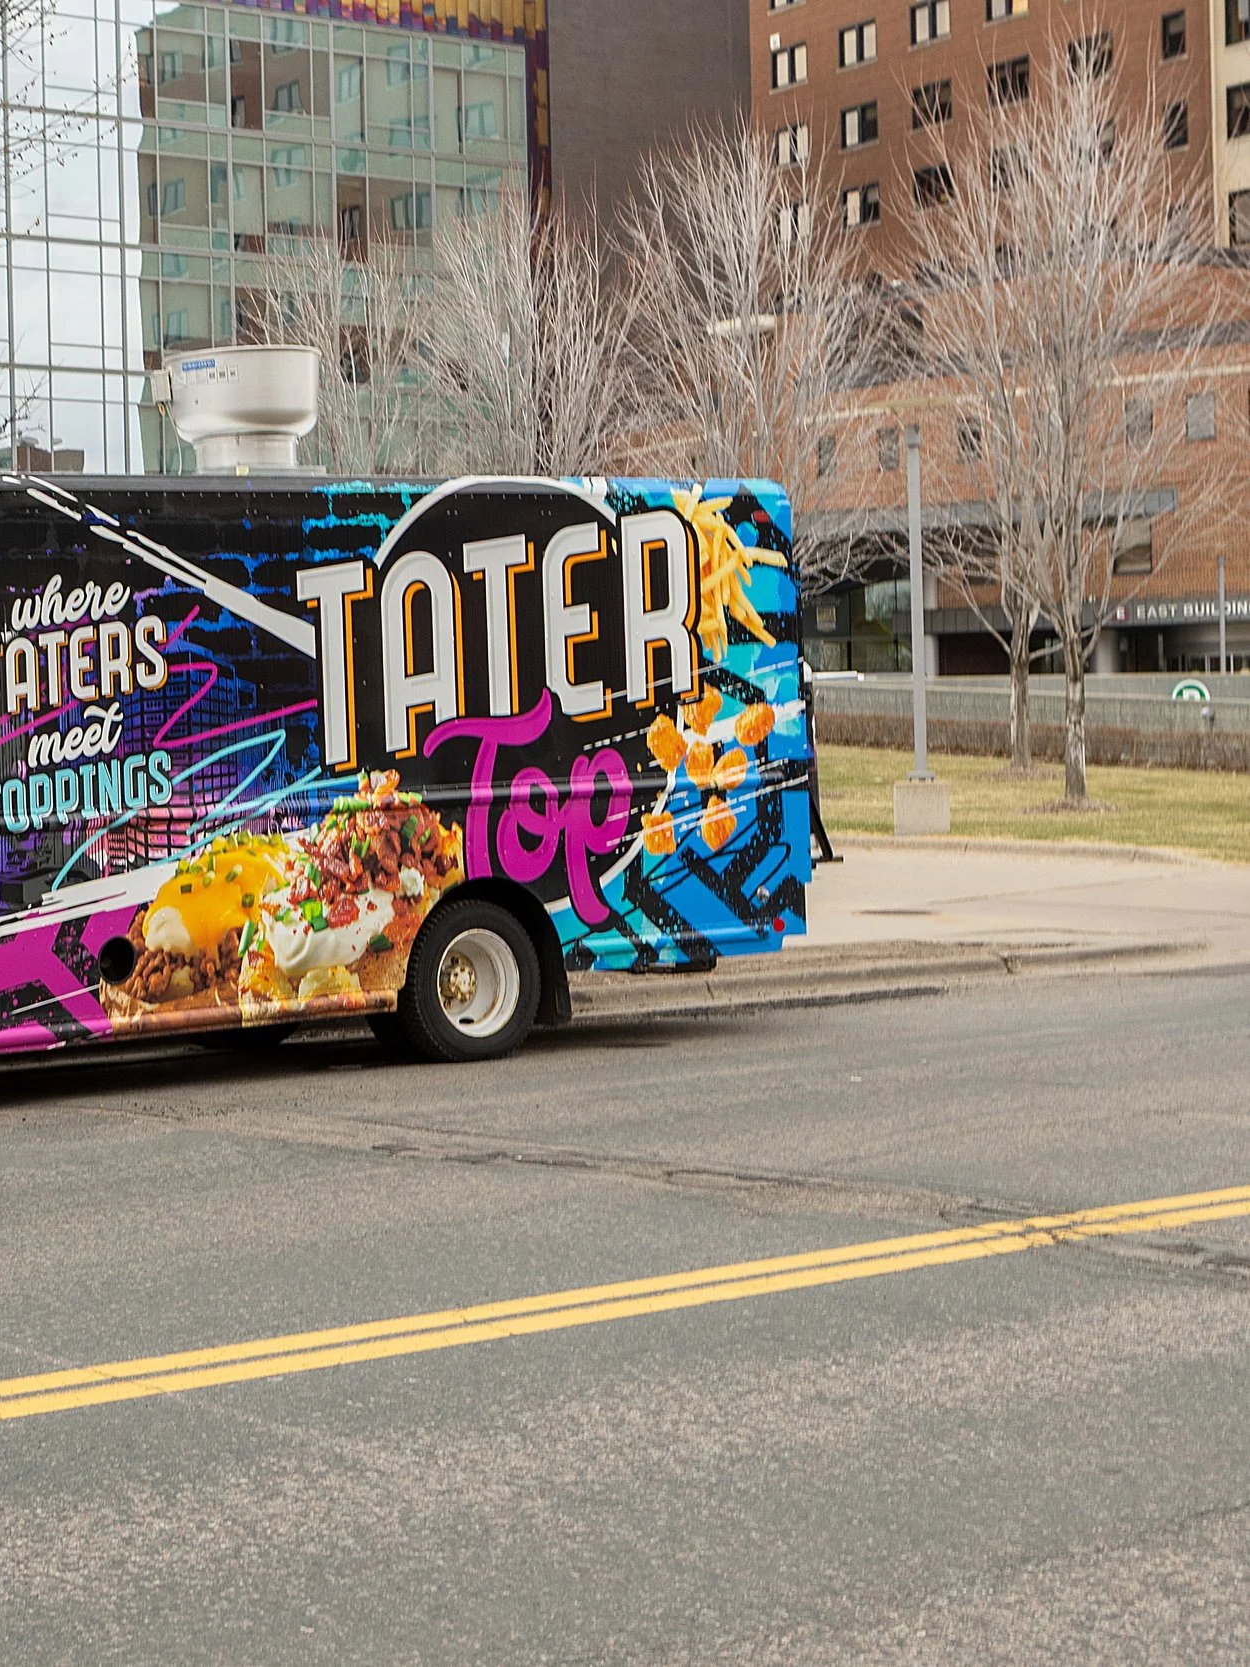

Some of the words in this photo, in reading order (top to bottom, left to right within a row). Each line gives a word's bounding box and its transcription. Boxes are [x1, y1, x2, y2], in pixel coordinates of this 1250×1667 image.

[11, 573, 130, 631] where
[1137, 603, 1177, 619] EAST
[1183, 600, 1250, 617] BUILDIN
[296, 509, 704, 771] TATER
[27, 701, 124, 768] meet
[423, 687, 633, 926] Top
